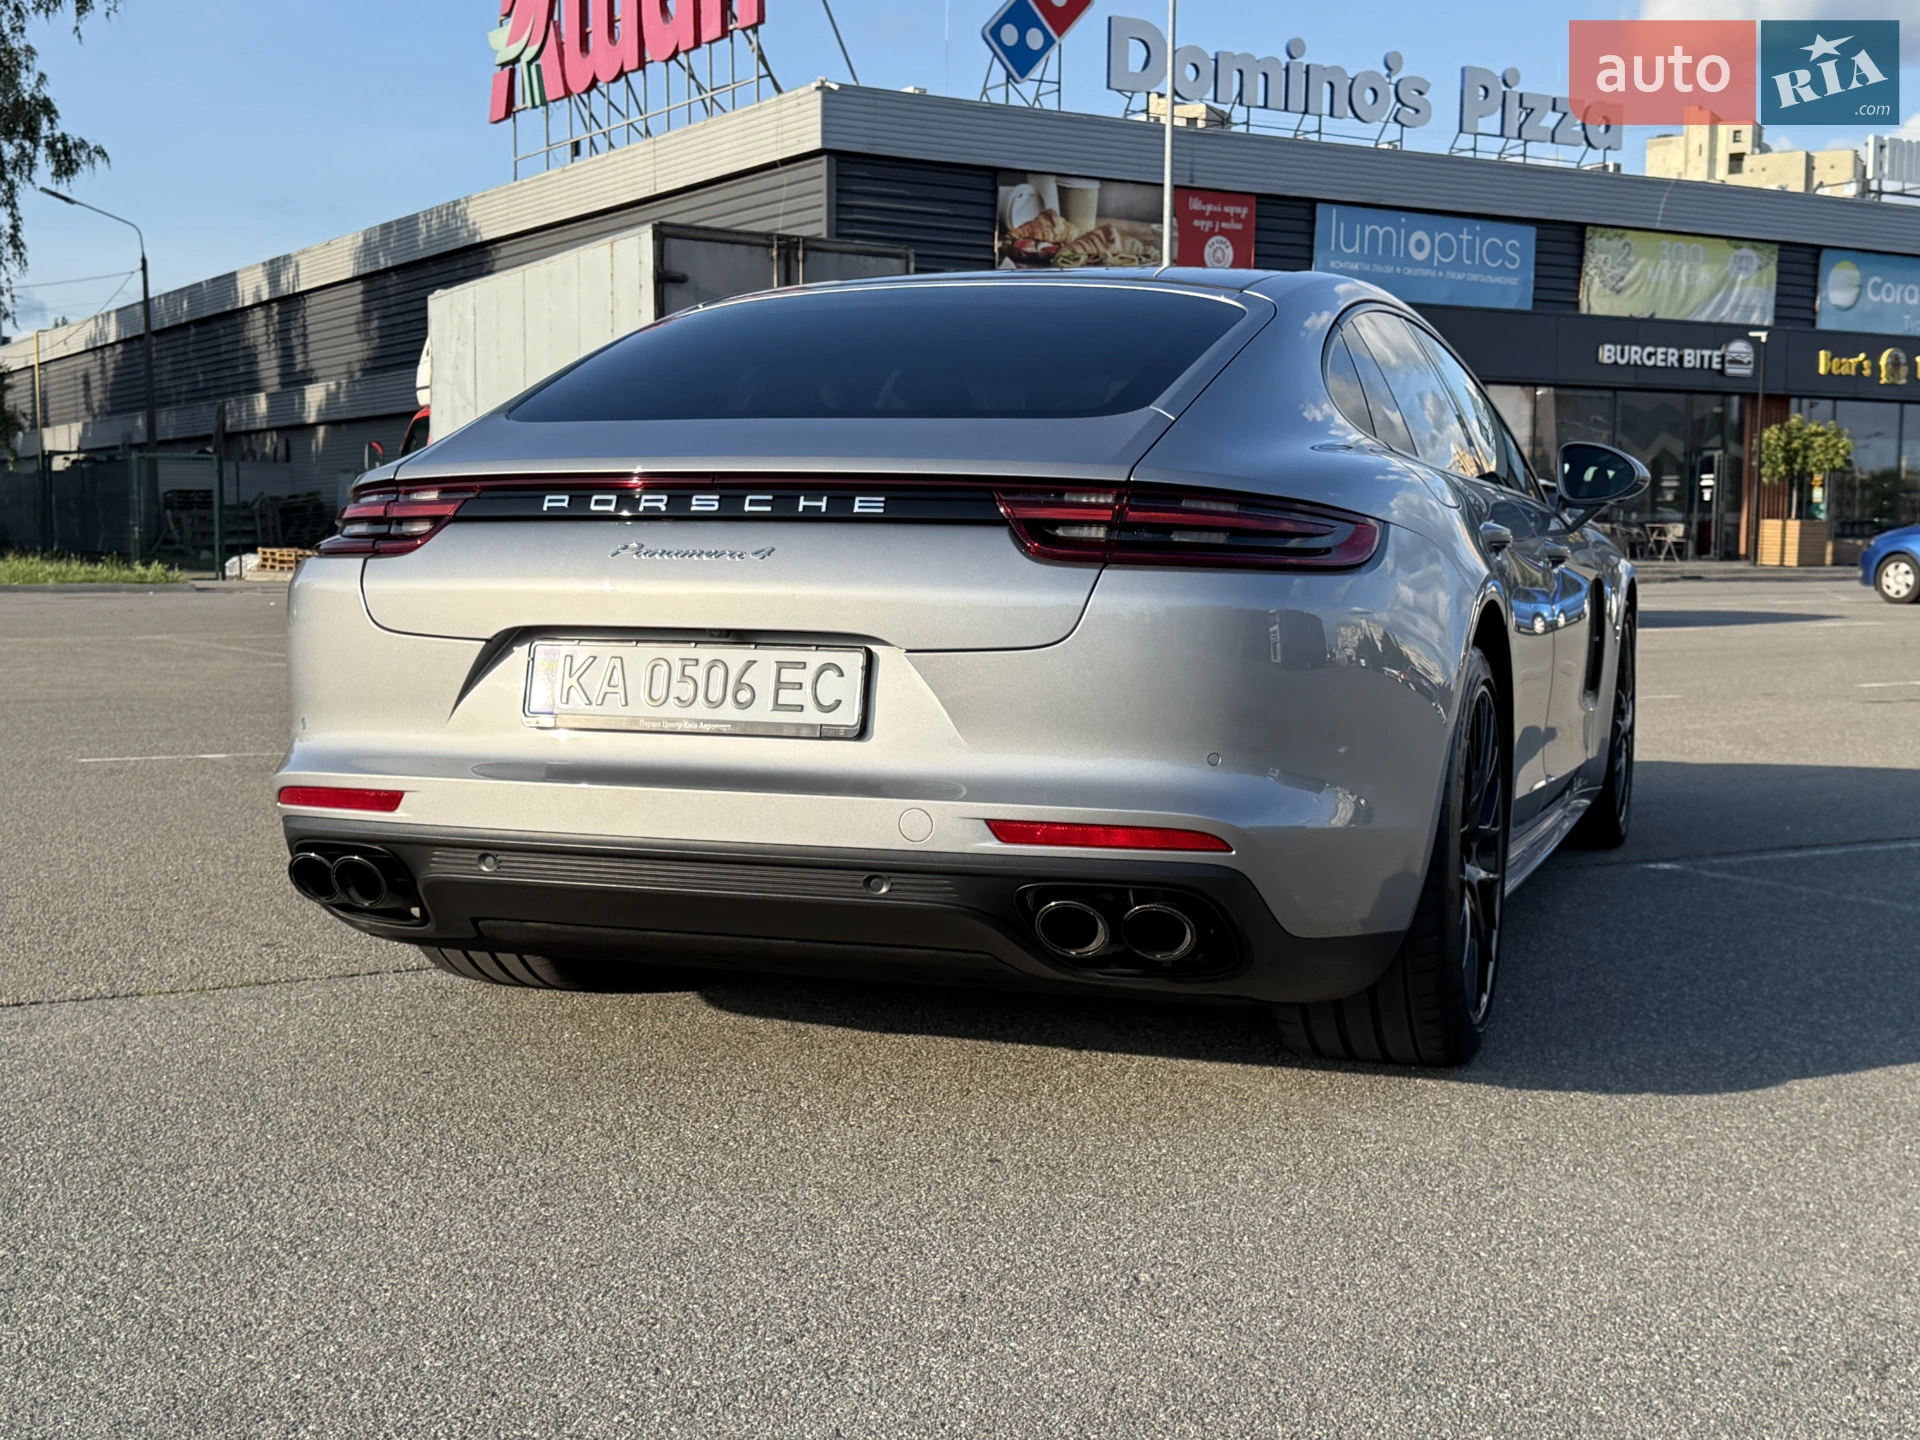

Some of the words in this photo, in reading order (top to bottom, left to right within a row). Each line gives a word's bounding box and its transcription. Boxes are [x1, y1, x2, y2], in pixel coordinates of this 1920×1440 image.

[1107, 15, 1433, 129] Domino's
[1460, 66, 1625, 151] Pizza
[1331, 208, 1521, 269] lumioptics
[1598, 343, 1679, 368] BURGER
[1682, 348, 1722, 370] BITE
[1818, 349, 1872, 378] Bear's
[542, 494, 886, 513] PORSCHE
[608, 541, 747, 561] Panamera
[750, 546, 776, 561] 4
[560, 655, 628, 708] KA
[643, 657, 757, 710] 0506
[769, 660, 845, 714] EC
